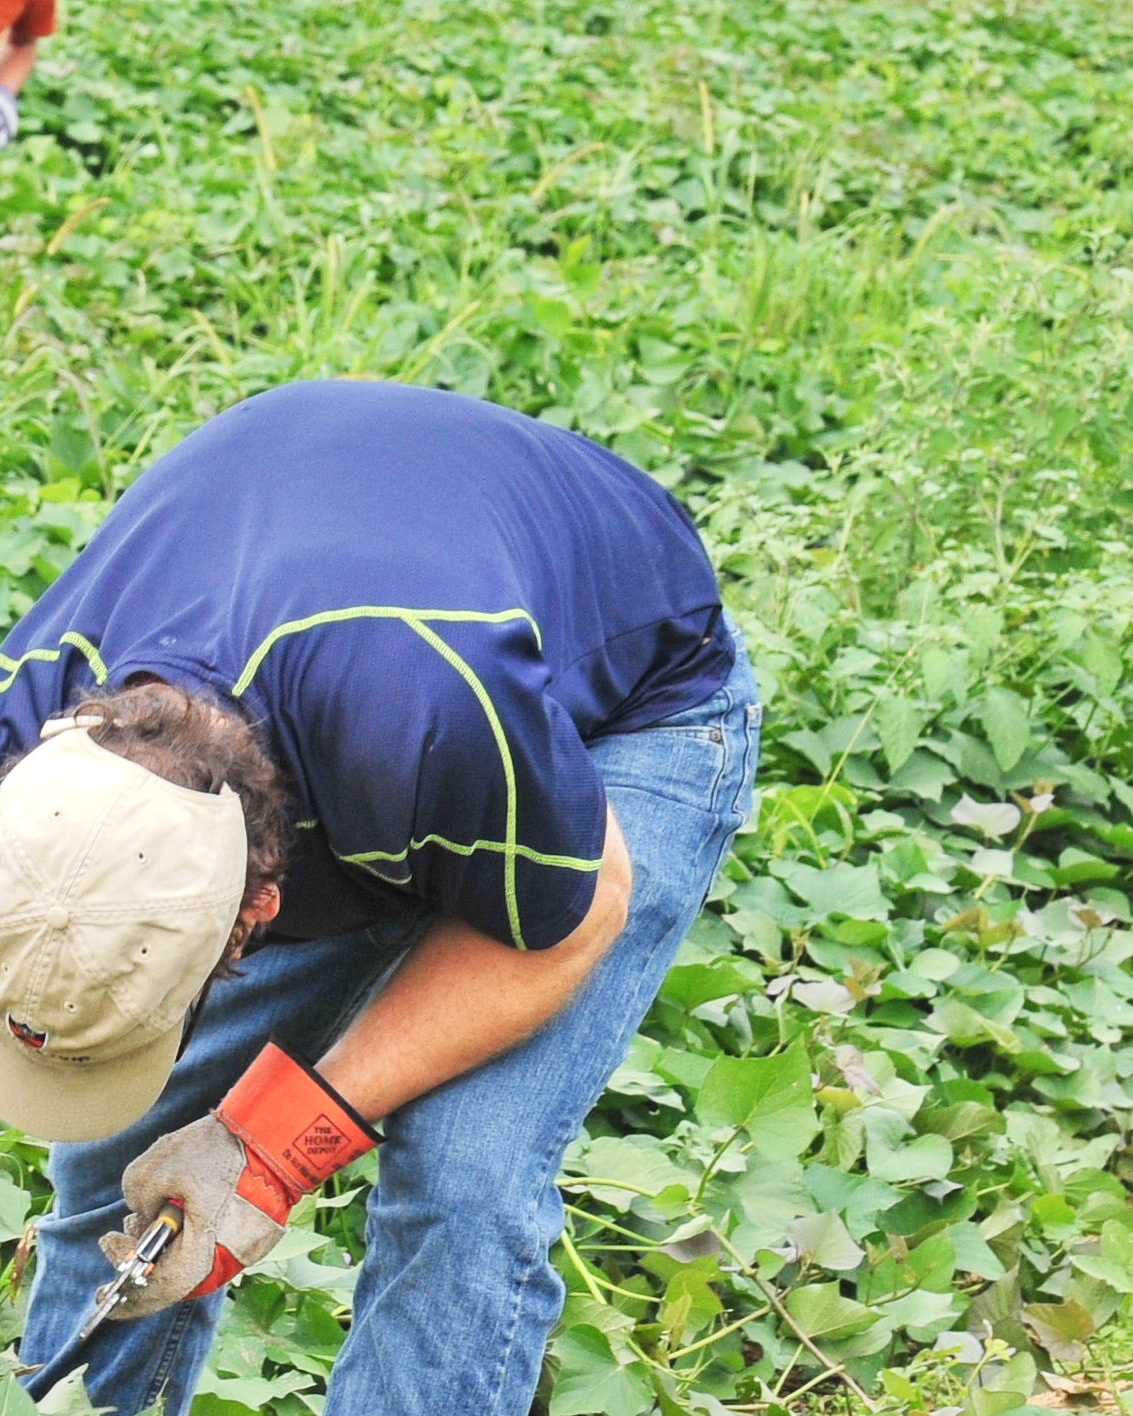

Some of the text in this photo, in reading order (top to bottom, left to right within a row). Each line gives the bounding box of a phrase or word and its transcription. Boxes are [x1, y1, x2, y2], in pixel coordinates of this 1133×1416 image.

[314, 1126, 332, 1134] THE
[304, 1135, 342, 1145] HOME
[307, 1146, 336, 1155] DEPOT
